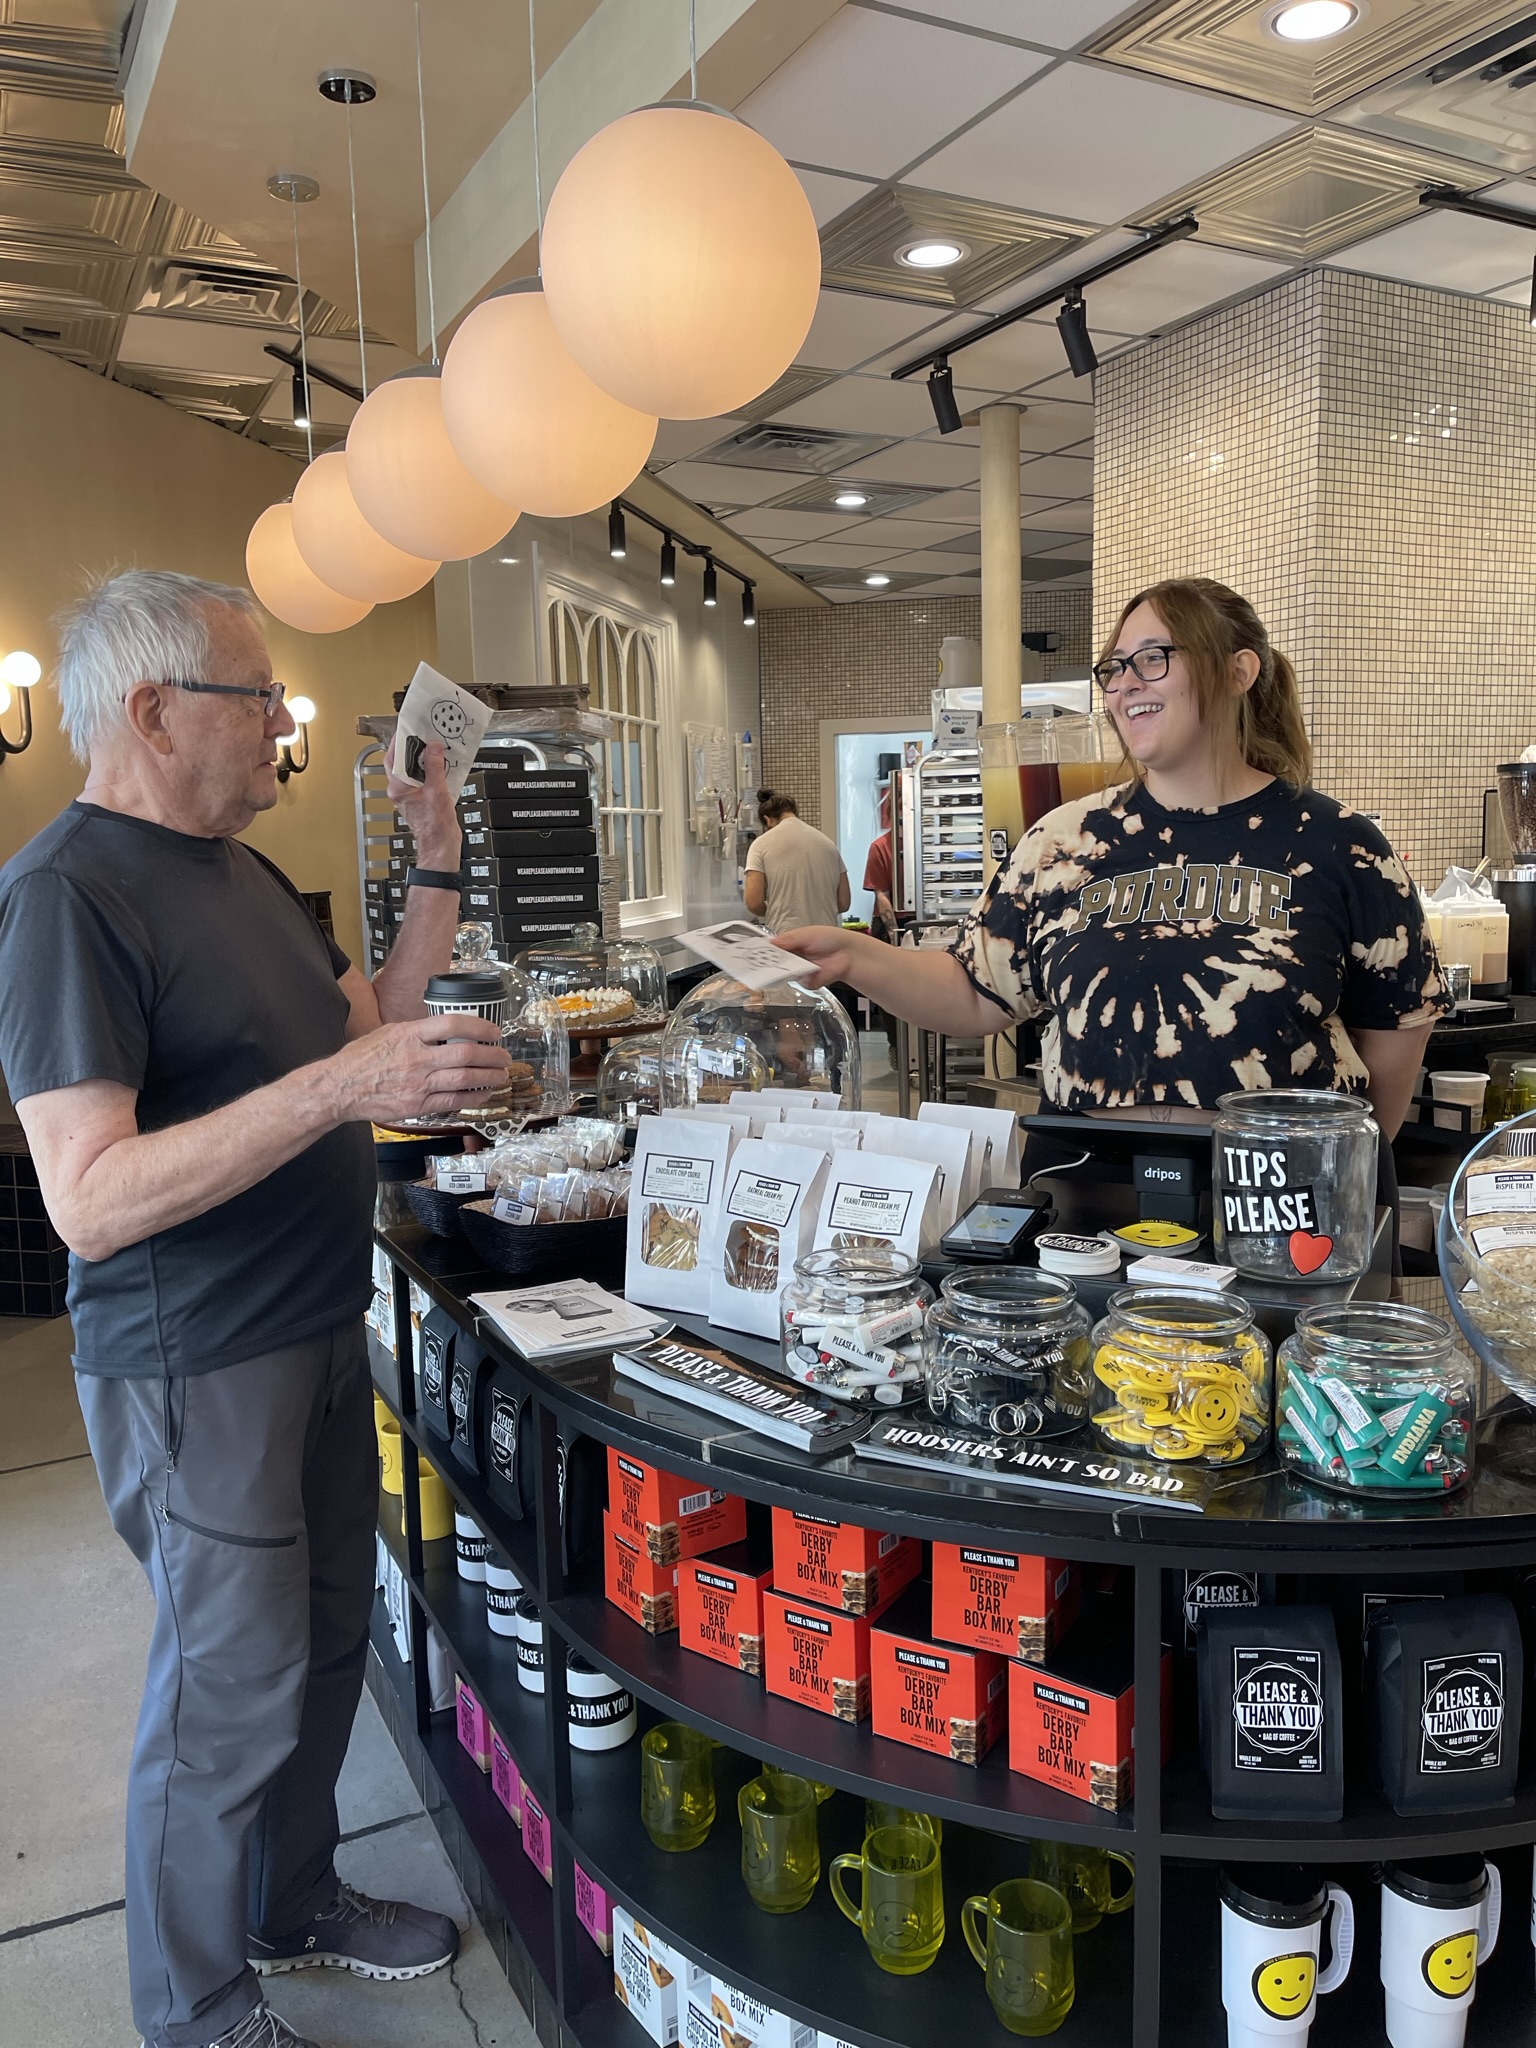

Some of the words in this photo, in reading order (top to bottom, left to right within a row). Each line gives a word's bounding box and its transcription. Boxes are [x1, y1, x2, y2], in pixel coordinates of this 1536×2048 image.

[1066, 863, 1291, 936] PURDUE
[656, 1167, 678, 1177] CHOCOLATE
[688, 1171, 701, 1179] COOKIE
[1144, 1167, 1181, 1181] dripos
[1223, 1147, 1287, 1187] TIPS
[747, 1187, 764, 1196] OATMEAL
[764, 1191, 777, 1199] CREAM
[843, 1196, 861, 1204] PEANUT
[861, 1199, 877, 1208] BUTTER
[878, 1202, 893, 1210] CREAM
[1224, 1192, 1314, 1232] PLEASE
[832, 1336, 852, 1350] PLEASE
[874, 1353, 886, 1363] YOU
[1044, 1351, 1064, 1364] YOU
[649, 1345, 723, 1379] PLEASE
[704, 1372, 730, 1385] &
[717, 1375, 792, 1409] THANK
[774, 1401, 827, 1424] YOU
[1061, 1403, 1083, 1416] YOU
[496, 1410, 514, 1434] PLEASE
[1391, 1407, 1438, 1465] INDIANA
[882, 1428, 1007, 1460] HOOSIERS
[1008, 1451, 1080, 1474] AIN'T
[1081, 1463, 1121, 1481] SO
[1125, 1471, 1185, 1493] BAD
[623, 1481, 640, 1505] DERBY
[626, 1498, 638, 1518] BAR
[621, 1509, 633, 1528] BOX
[633, 1518, 645, 1537] MIX
[464, 1545, 470, 1556] &
[801, 1531, 832, 1554] DERBY
[618, 1552, 635, 1575] DERBY
[807, 1549, 827, 1569] BAR
[964, 1551, 982, 1563] PLEASE
[987, 1555, 1004, 1566] THANK
[1004, 1558, 1015, 1567] YOU
[622, 1569, 633, 1588] BAR
[697, 1573, 711, 1584] PLEASE
[714, 1578, 726, 1588] THANK
[726, 1581, 734, 1590] YOU
[797, 1562, 817, 1582] BOX
[819, 1569, 838, 1589] MIX
[970, 1575, 1008, 1599] DERBY
[489, 1594, 494, 1606] &
[617, 1578, 627, 1598] BOX
[628, 1588, 639, 1607] MIX
[977, 1594, 1001, 1615] BAR
[1196, 1585, 1240, 1603] PLEASE
[1242, 1589, 1249, 1601] &
[703, 1595, 730, 1617] DERBY
[708, 1612, 726, 1631] BAR
[787, 1614, 803, 1625] PLEASE
[806, 1619, 820, 1630] THANK
[820, 1623, 828, 1632] YOU
[964, 1609, 987, 1630] BOX
[991, 1615, 1014, 1636] MIX
[700, 1623, 717, 1643] BOX
[719, 1632, 736, 1650] MIX
[793, 1637, 824, 1660] DERBY
[799, 1654, 818, 1675] BAR
[899, 1651, 916, 1663] PLEASE
[920, 1656, 936, 1668] THANK
[936, 1660, 946, 1669] YOU
[789, 1666, 808, 1687] BOX
[811, 1675, 830, 1696] MIX
[905, 1675, 940, 1700] DERBY
[1247, 1681, 1297, 1703] PLEASE
[1300, 1689, 1309, 1703] &
[570, 1704, 576, 1717] &
[576, 1702, 611, 1720] THANK
[612, 1694, 629, 1715] YOU
[912, 1694, 934, 1715] BAR
[1037, 1687, 1055, 1700] PLEASE
[1059, 1694, 1075, 1707] THANK
[1075, 1700, 1086, 1710] YOU
[1436, 1686, 1480, 1711] PLEASE
[1483, 1692, 1492, 1706] &
[900, 1707, 922, 1729] BOX
[925, 1715, 946, 1736] MIX
[1043, 1712, 1079, 1741] DERBY
[1240, 1704, 1286, 1726] THANK
[1289, 1705, 1316, 1728] YOU
[1429, 1709, 1469, 1733] THANK
[1472, 1708, 1498, 1728] YOU
[1050, 1732, 1073, 1757] BAR
[1279, 1733, 1296, 1741] COFFEE
[1449, 1737, 1458, 1745] BAG
[1458, 1736, 1463, 1744] OF
[1463, 1735, 1478, 1743] COFFEE
[1038, 1745, 1060, 1770] BOX
[1064, 1755, 1086, 1780] MIX
[621, 1944, 650, 1987] CHOCOLATE
[620, 1957, 632, 1980] CHIP
[632, 1970, 652, 2002] COOKIE
[625, 1979, 636, 1998] BOX
[636, 1989, 647, 2011] MIX
[730, 1994, 747, 2017] BOX
[749, 2005, 765, 2027] MIX
